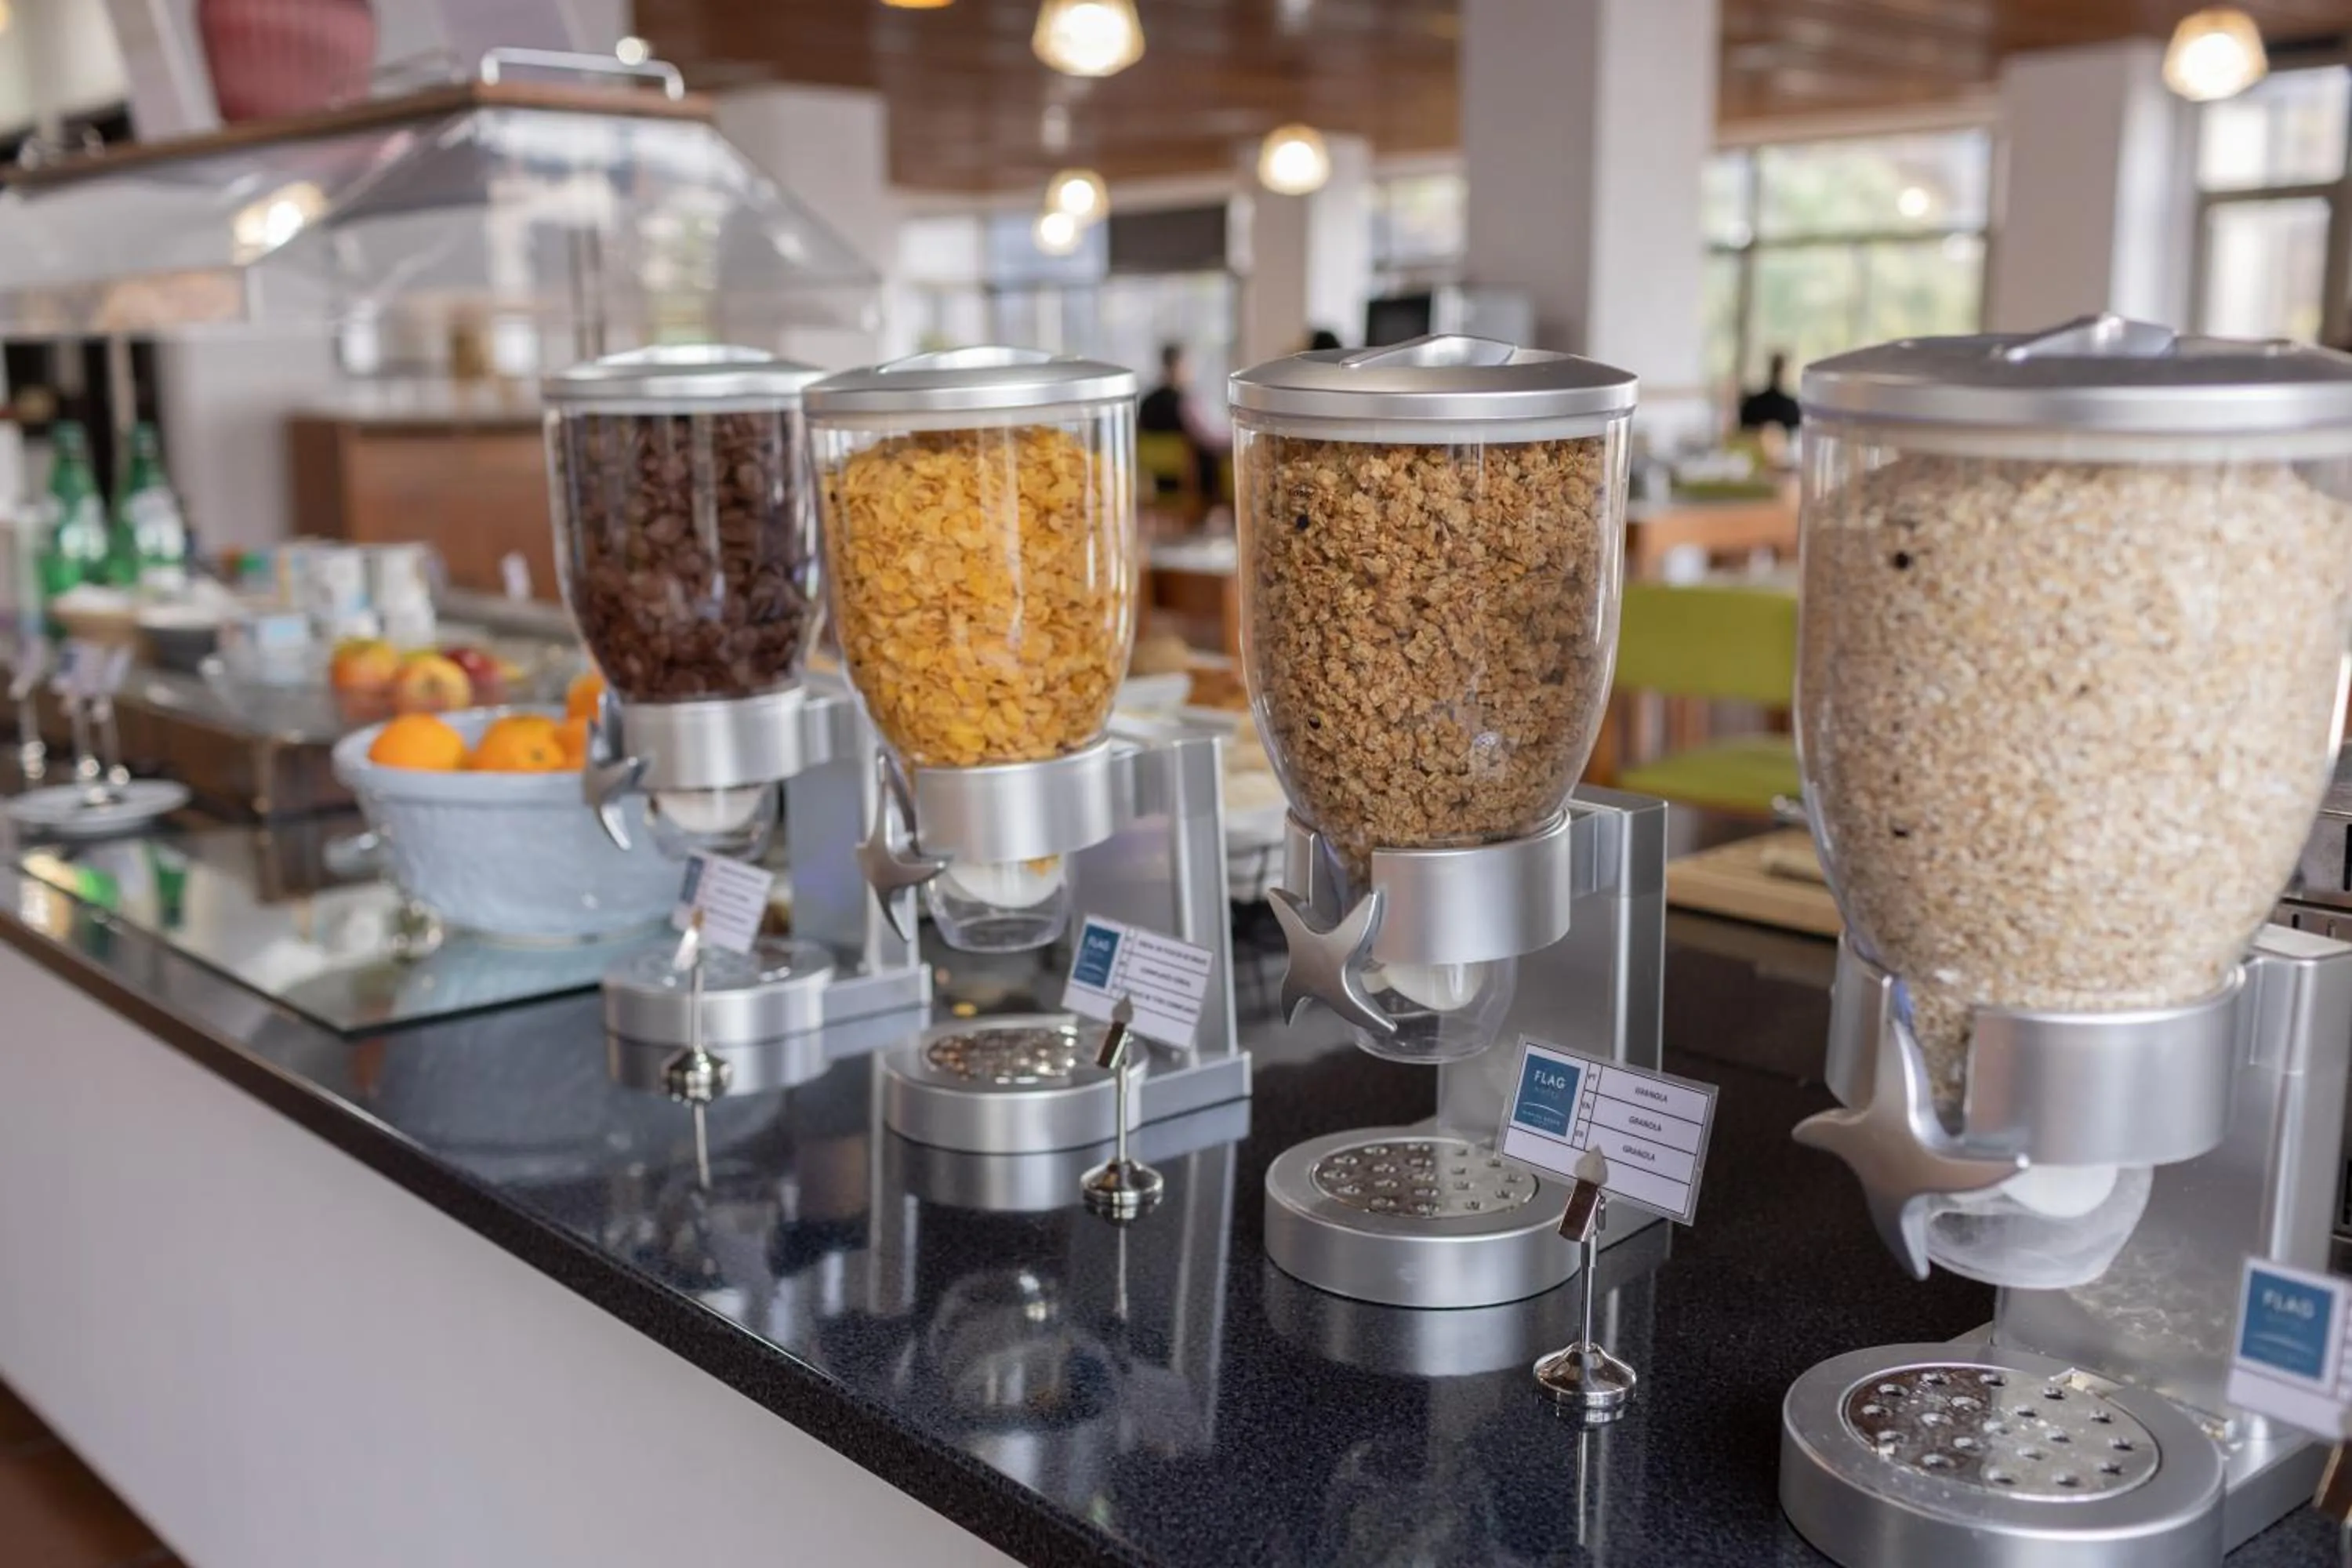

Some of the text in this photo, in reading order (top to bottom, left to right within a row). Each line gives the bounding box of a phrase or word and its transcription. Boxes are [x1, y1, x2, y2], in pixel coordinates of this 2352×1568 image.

[1534, 1069, 1567, 1090] FLAG
[1635, 1086, 1668, 1103] GRANOLA
[1628, 1116, 1661, 1132] GRANOLA
[1622, 1145, 1656, 1161] GRANOLA
